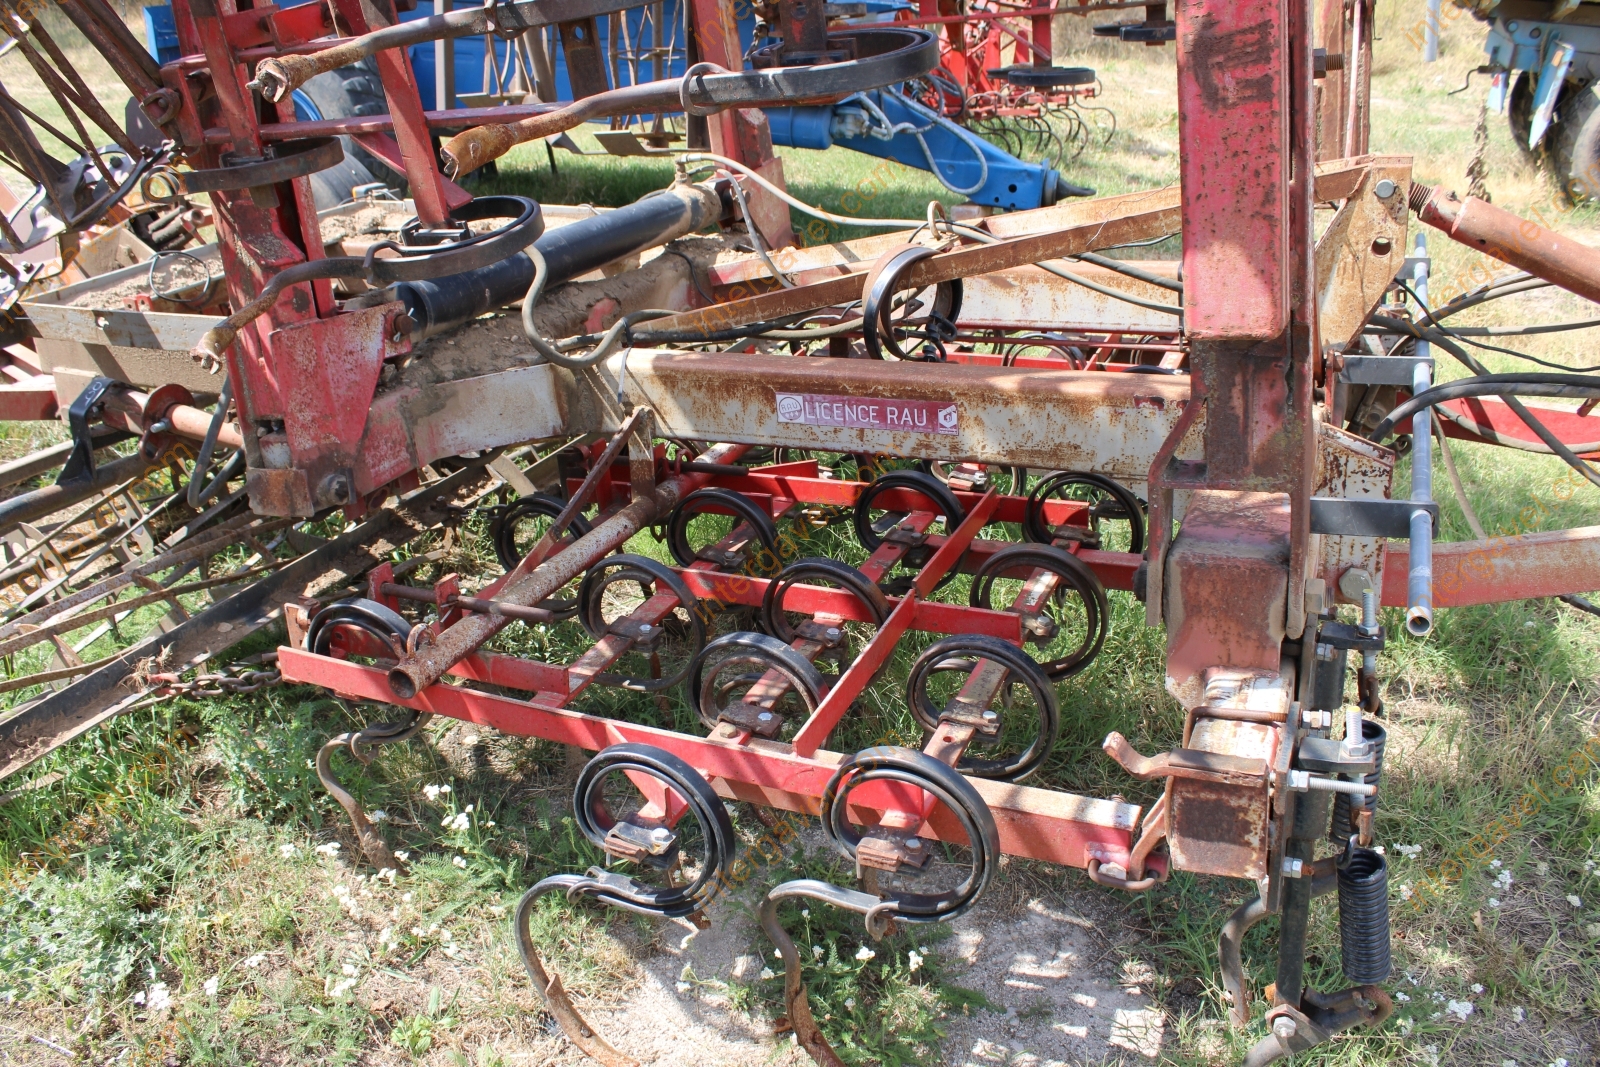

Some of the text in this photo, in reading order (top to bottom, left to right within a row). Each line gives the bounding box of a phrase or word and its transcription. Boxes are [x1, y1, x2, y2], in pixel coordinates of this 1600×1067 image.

[781, 401, 798, 412] RAU
[805, 401, 927, 427] LICENCE RAU
